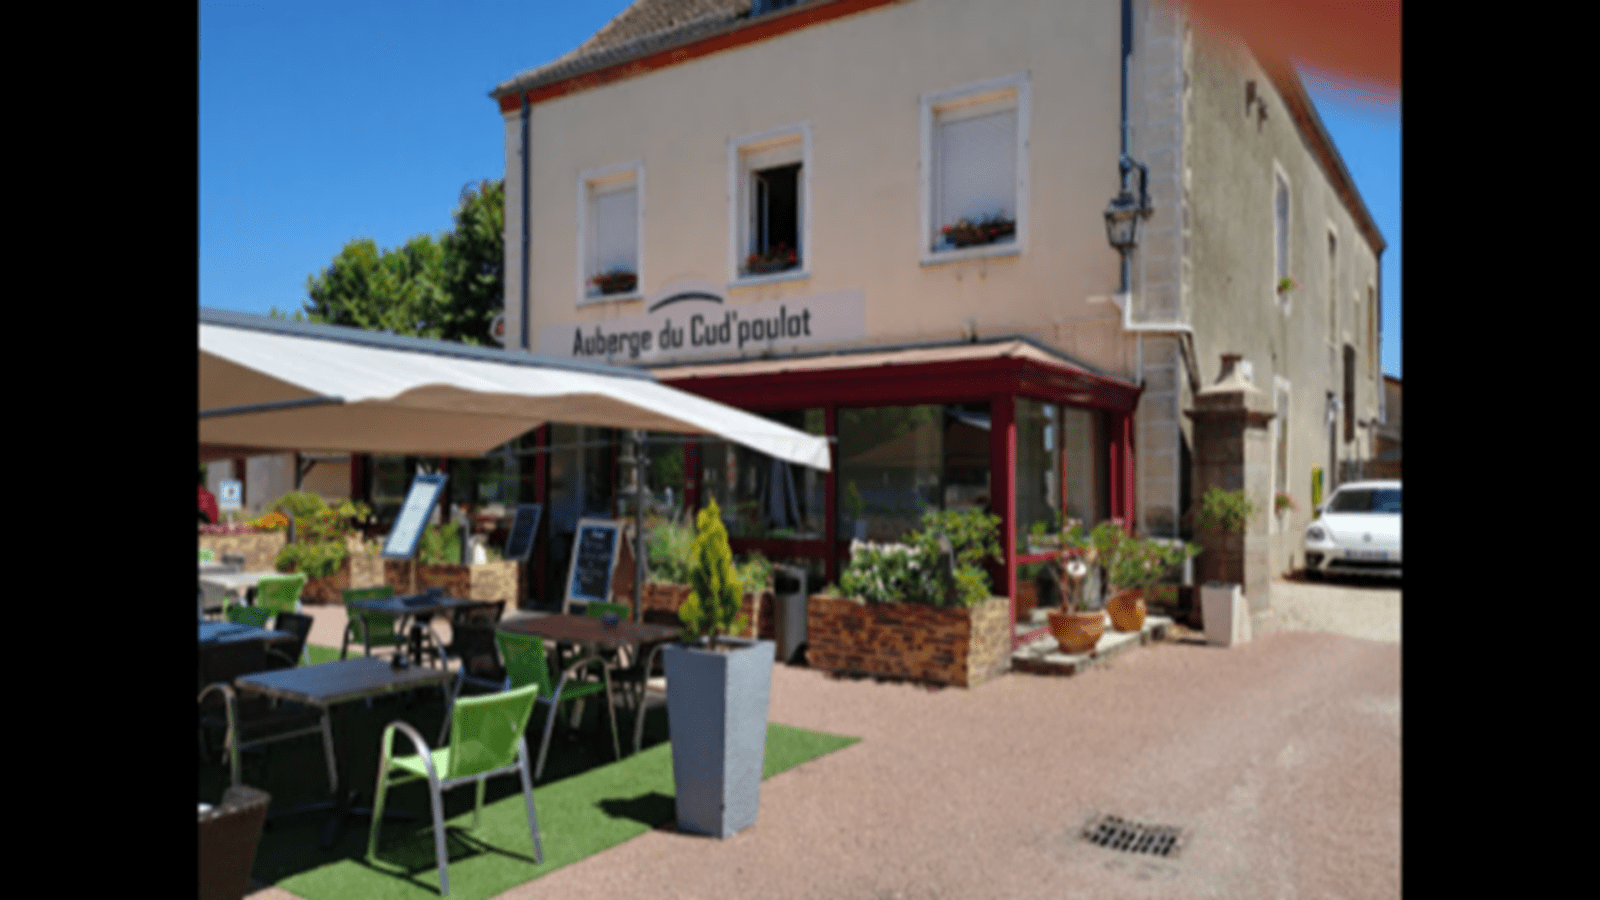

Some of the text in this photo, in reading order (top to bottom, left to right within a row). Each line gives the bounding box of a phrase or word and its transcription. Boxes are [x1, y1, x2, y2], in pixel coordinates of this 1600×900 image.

[572, 304, 812, 359] Auberge du Cud'poulot
